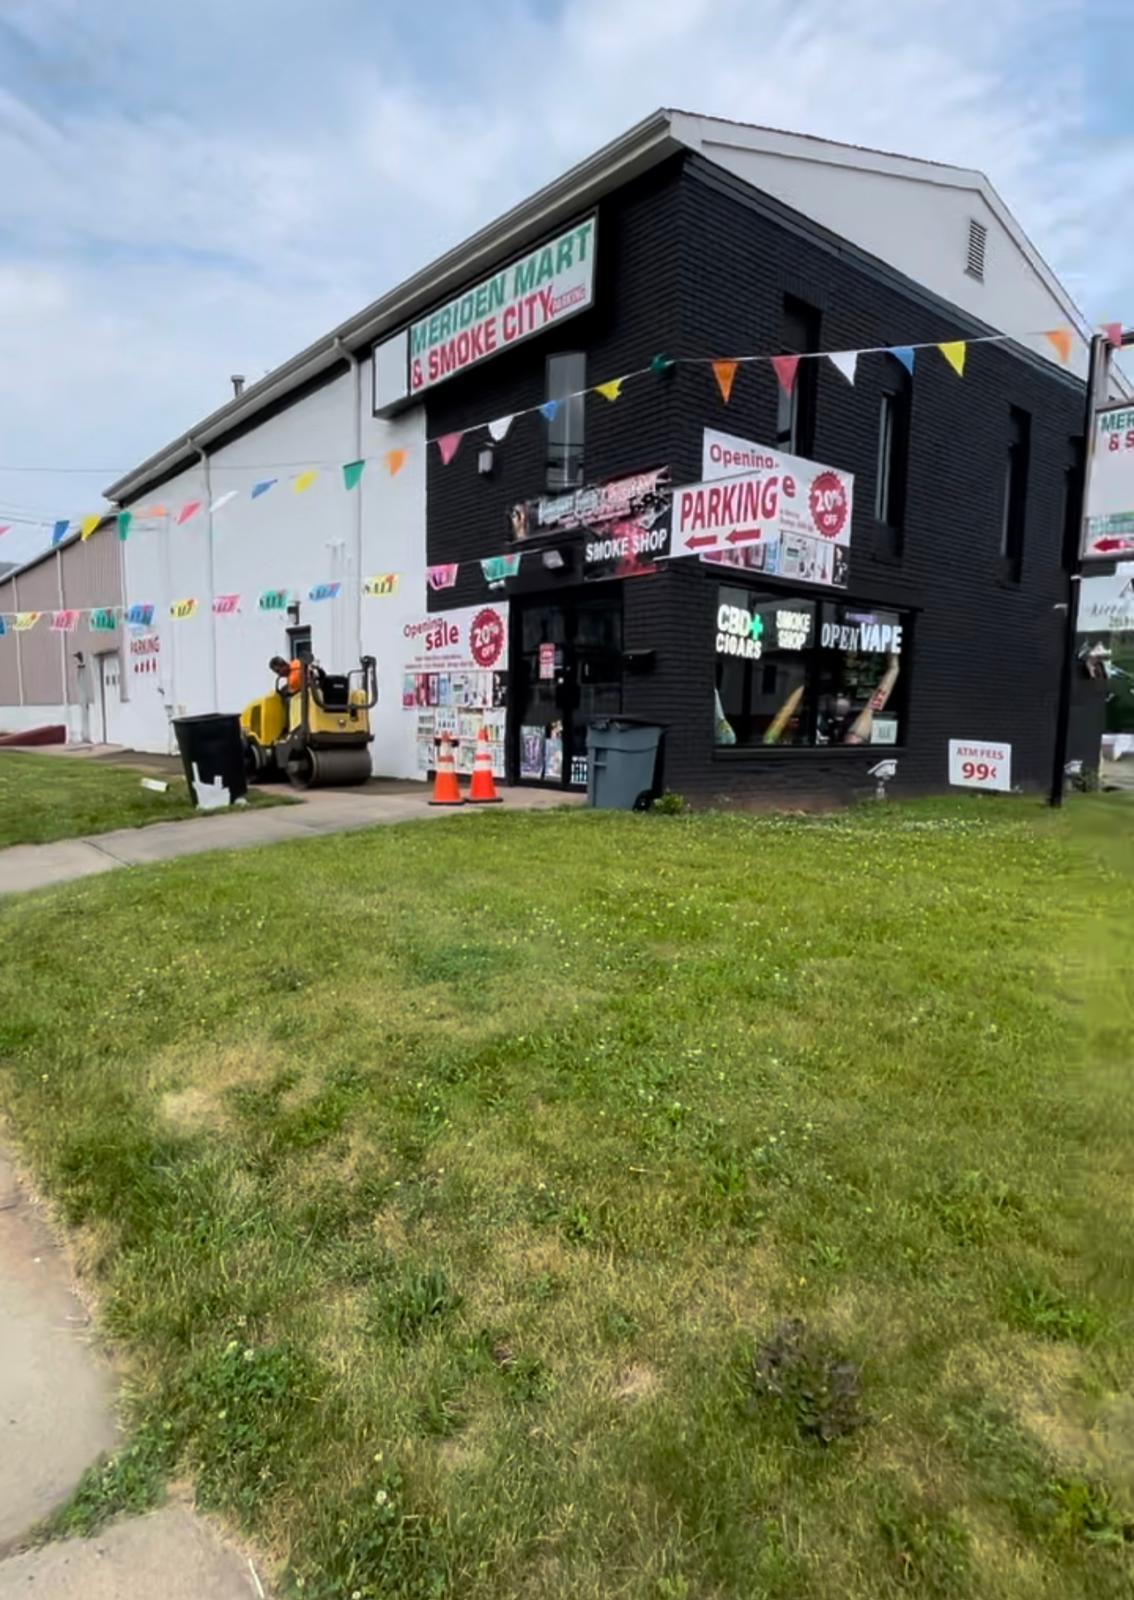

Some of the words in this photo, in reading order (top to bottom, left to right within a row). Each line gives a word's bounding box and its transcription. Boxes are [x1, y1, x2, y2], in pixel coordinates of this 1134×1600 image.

[412, 273, 506, 356] MERIDEN
[514, 223, 592, 298] MART
[412, 358, 423, 389] &
[429, 316, 496, 381] SMOKE
[503, 285, 554, 342] CITY
[680, 476, 778, 533] PARKING
[823, 514, 839, 526] OFF
[585, 536, 629, 563] SMOKE
[633, 528, 668, 555] SHOP
[403, 617, 443, 639] Opening
[425, 620, 459, 651] sale
[776, 609, 811, 632] SMOKE
[777, 629, 806, 650] SHOP
[821, 622, 860, 652] OPEN
[860, 622, 903, 654] VAPE
[957, 747, 978, 756] ATM
[980, 749, 1004, 760] FEES
